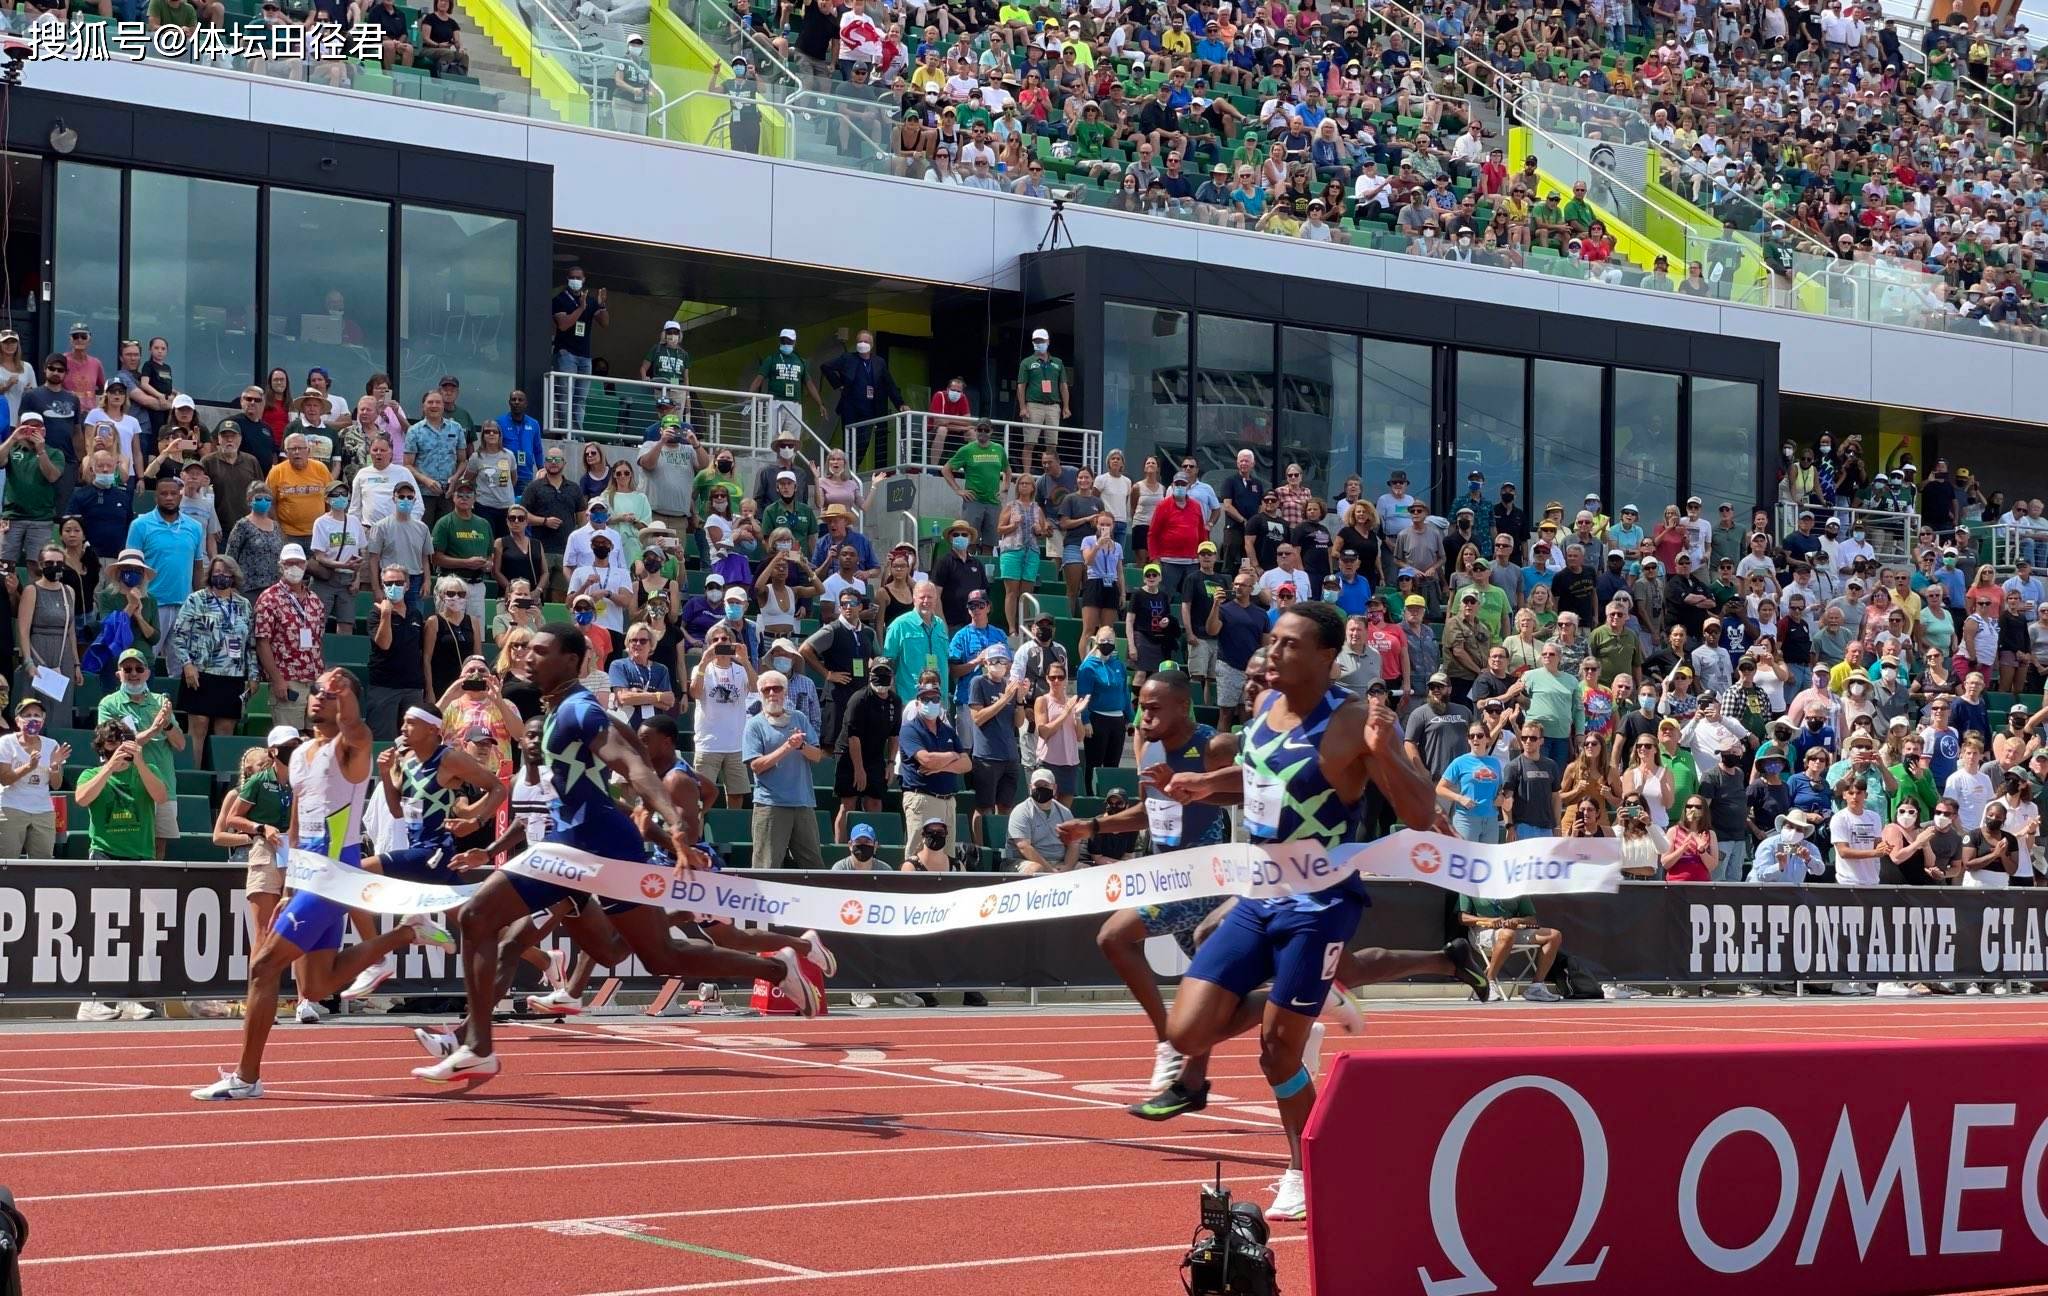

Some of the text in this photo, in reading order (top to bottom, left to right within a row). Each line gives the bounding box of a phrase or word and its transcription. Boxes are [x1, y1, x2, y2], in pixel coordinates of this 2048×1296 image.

[1449, 853, 1491, 884] BD
[671, 879, 706, 902] BD
[1125, 873, 1146, 897] BD
[867, 904, 895, 924] BD
[998, 893, 1021, 914] BD
[1689, 904, 2048, 974] PREFONTAINE CLA
[1327, 945, 1341, 976] 2
[1677, 1101, 2048, 1274] OME
